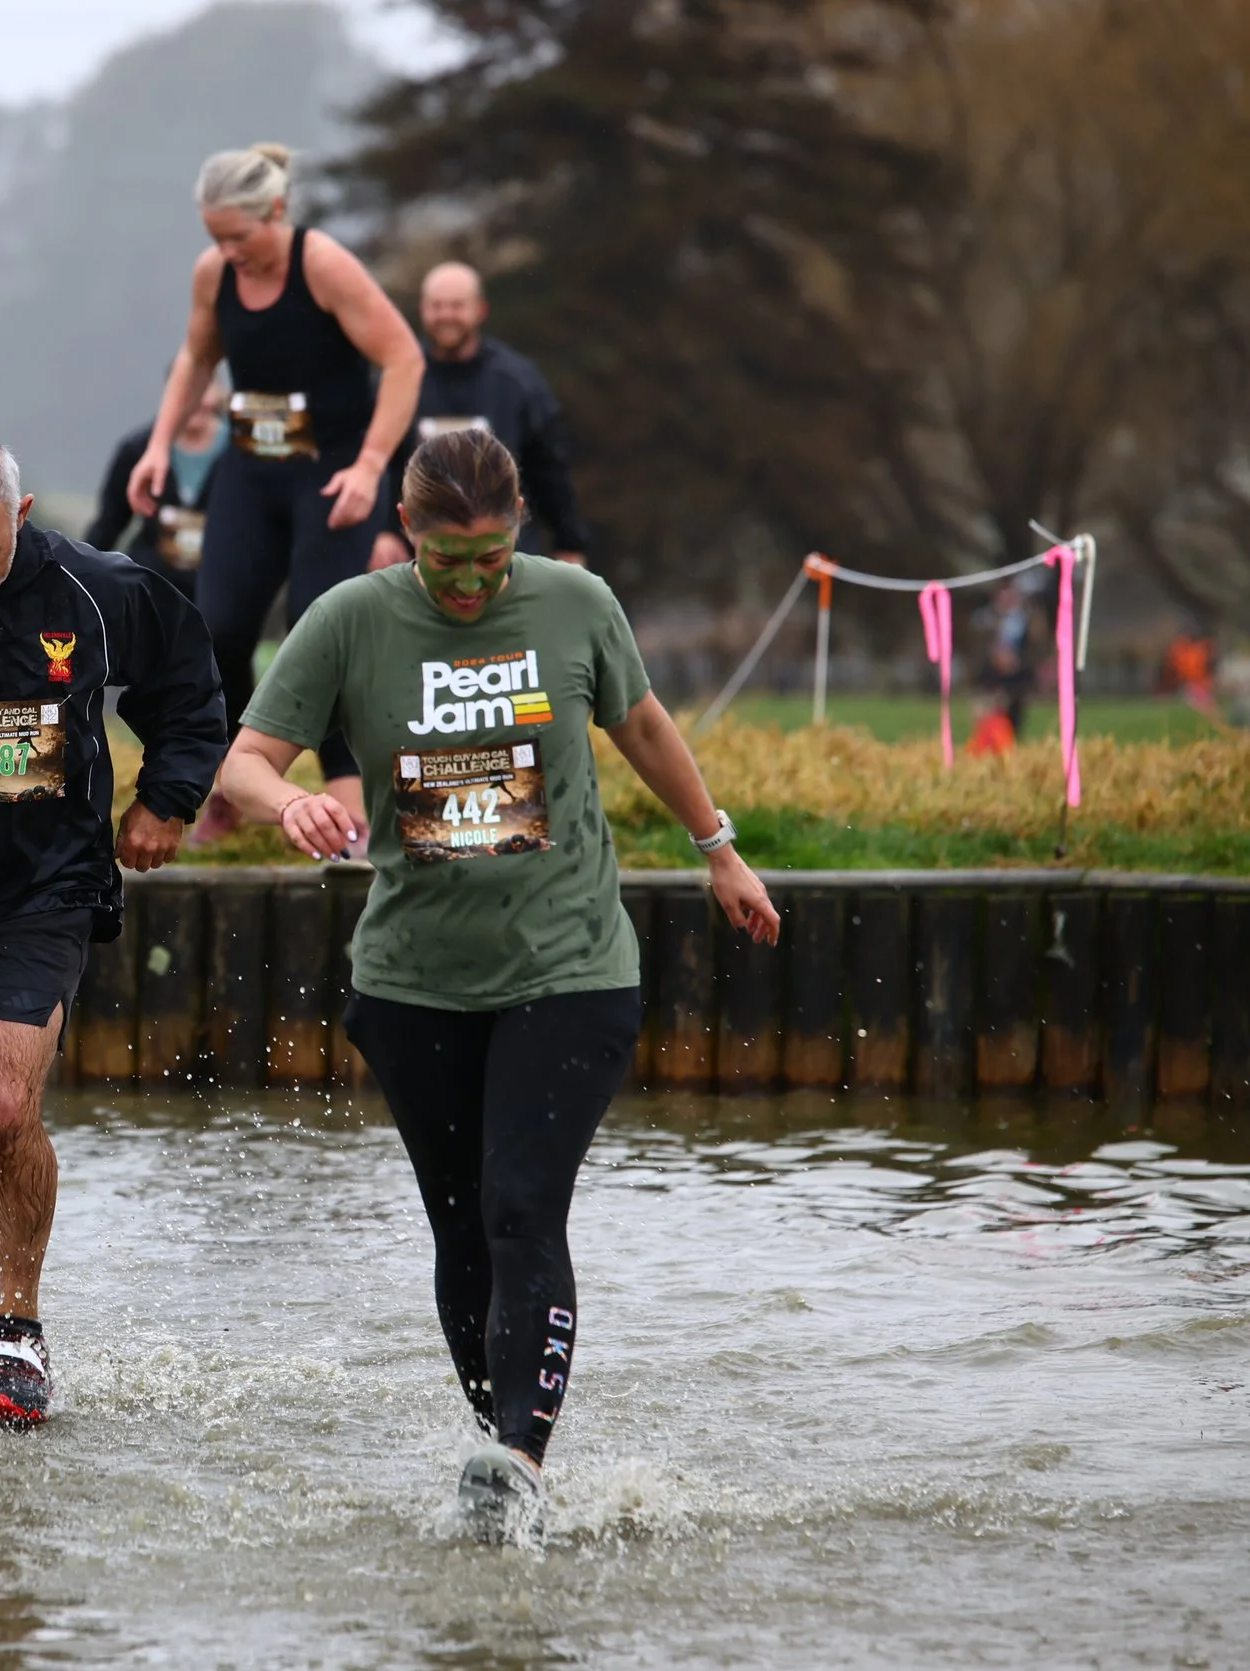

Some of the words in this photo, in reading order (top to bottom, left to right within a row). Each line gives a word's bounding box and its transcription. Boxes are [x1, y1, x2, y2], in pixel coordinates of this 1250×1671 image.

[453, 659, 487, 668] 2024
[490, 652, 524, 663] TOUR
[422, 650, 539, 698] Pearl
[407, 692, 515, 735] Jam
[422, 755, 452, 765] TOUGH
[453, 753, 471, 763] GUY
[471, 752, 490, 761] AND
[491, 751, 509, 760] GAL
[423, 758, 510, 776] CHALLENGE
[442, 788, 501, 827] 442
[450, 828, 499, 848] NICOLE
